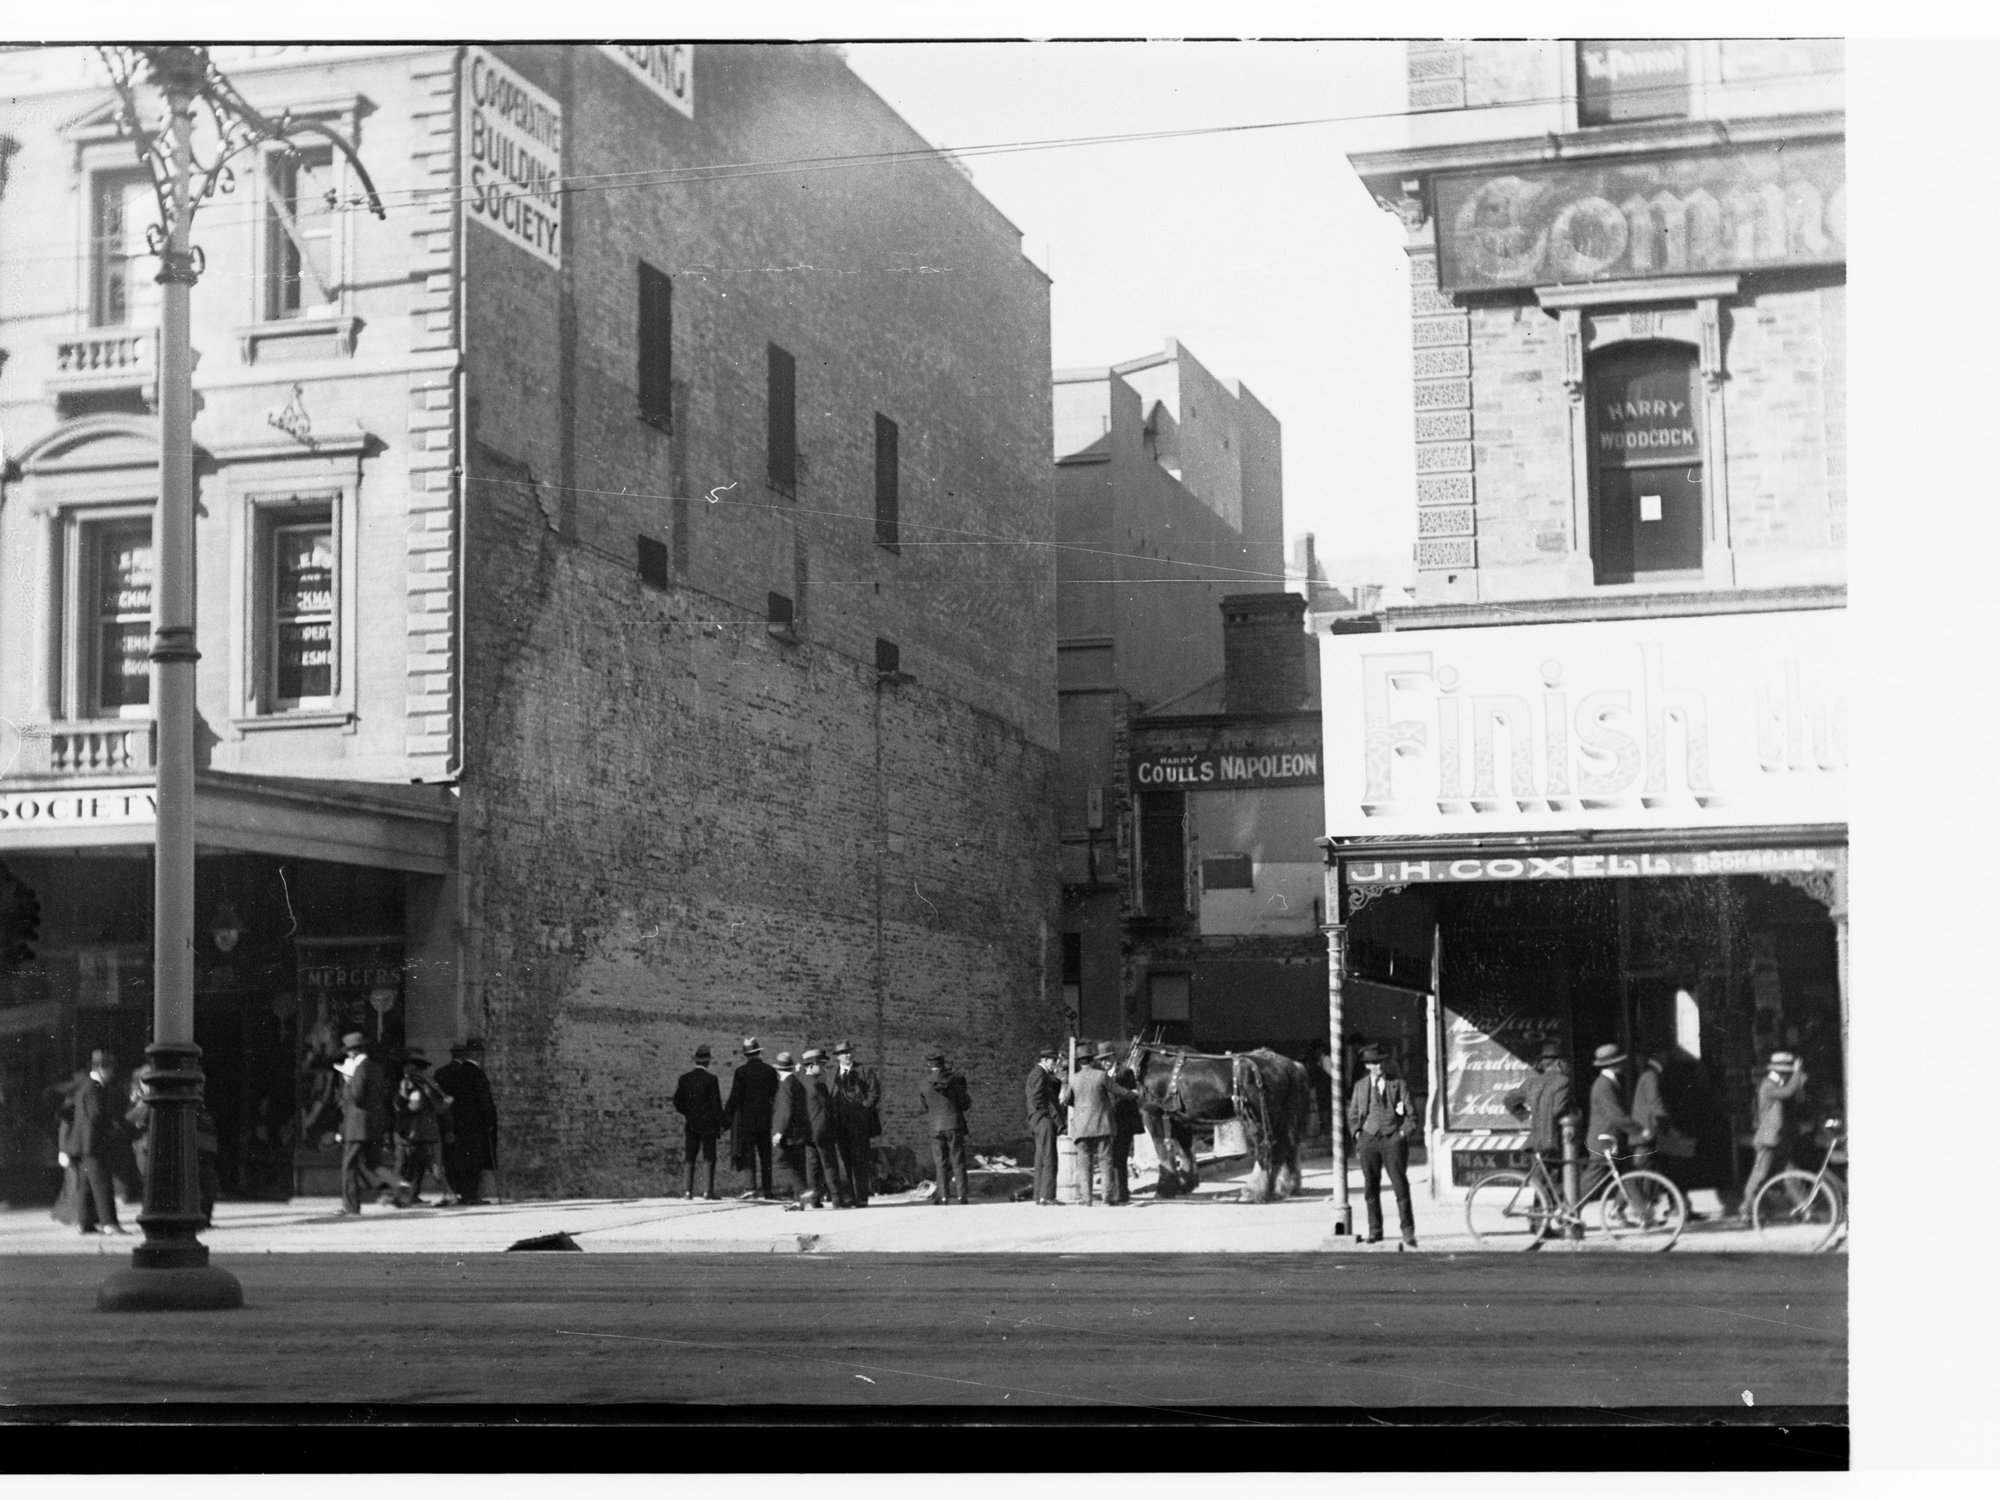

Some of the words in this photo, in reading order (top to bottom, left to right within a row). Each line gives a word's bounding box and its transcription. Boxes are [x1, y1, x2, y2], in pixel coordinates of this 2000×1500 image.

[471, 107, 558, 209] BUILDING
[471, 164, 558, 254] SOCIETY
[1608, 400, 1685, 421] HARRY
[1601, 428, 1694, 450] WOODCOCK
[300, 574, 321, 582] AND
[1361, 641, 1720, 814] Finish
[1138, 761, 1214, 783] COULLS
[1220, 753, 1317, 780] NAPOLEON
[1160, 755, 1197, 764] HARRY
[1493, 1079, 1527, 1091] and
[1456, 1153, 1496, 1168] MAX
